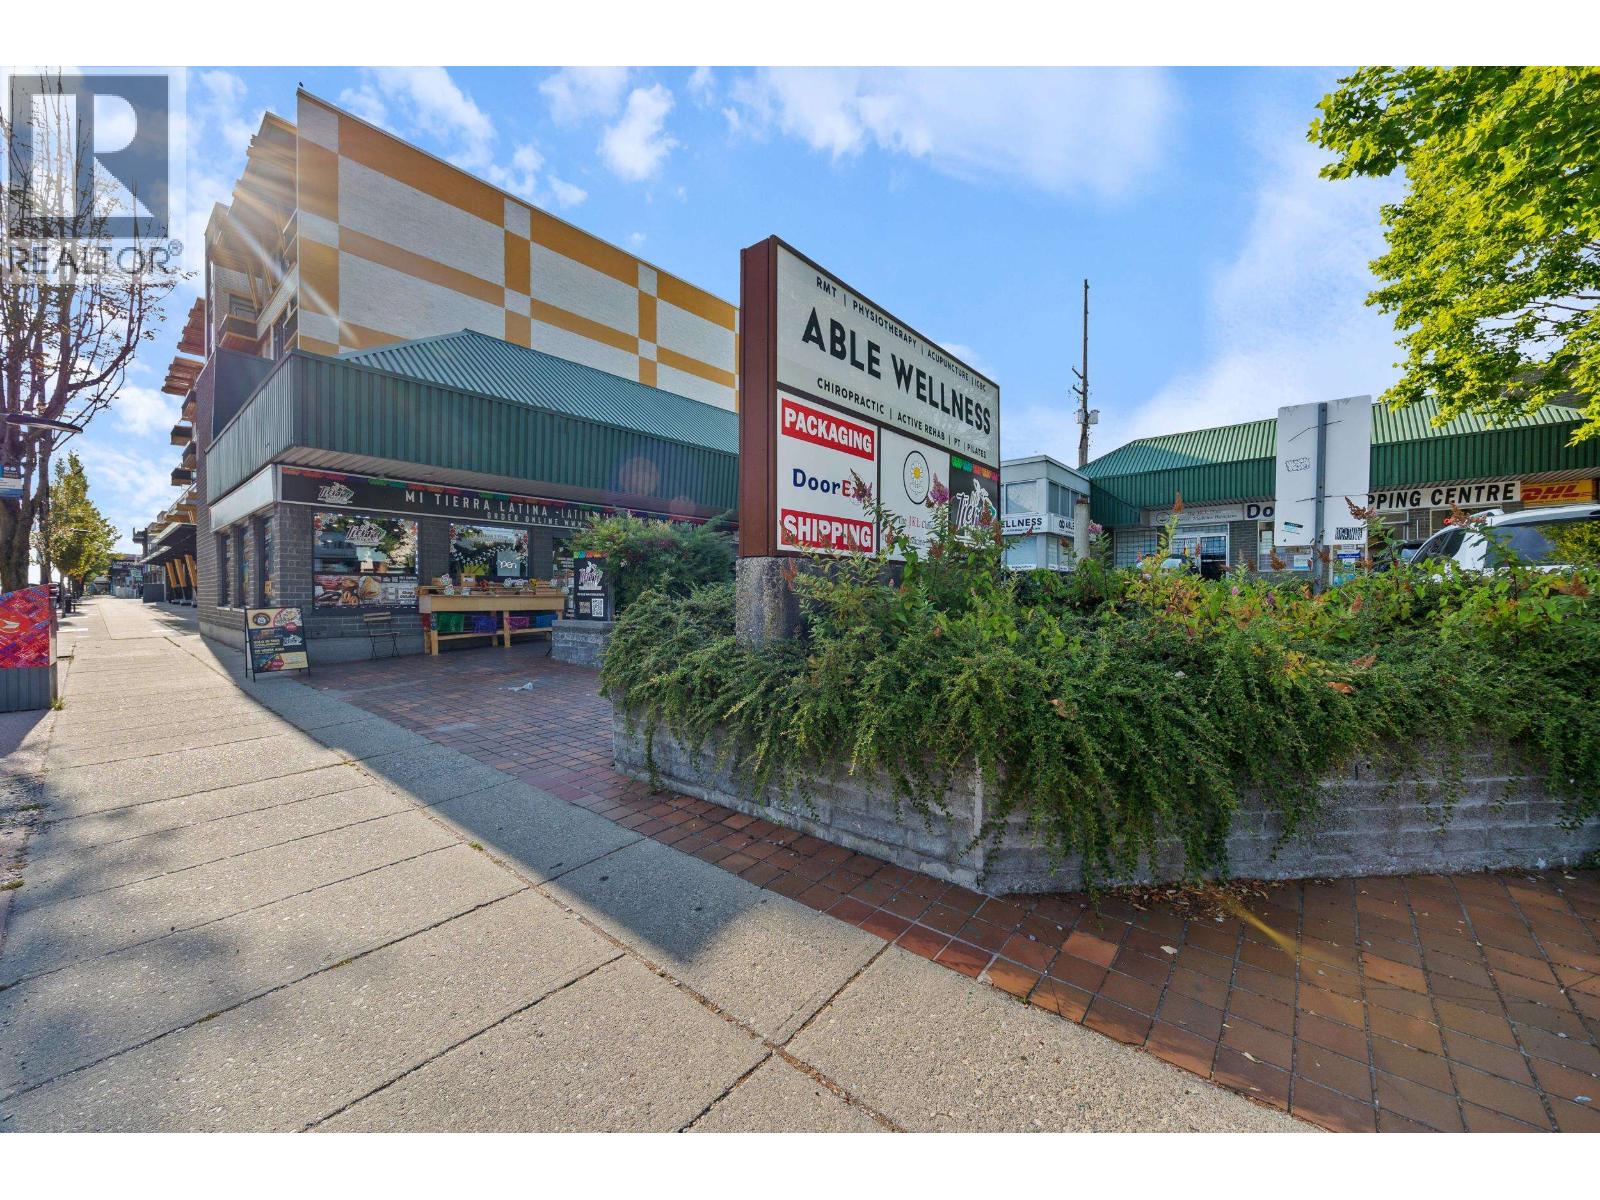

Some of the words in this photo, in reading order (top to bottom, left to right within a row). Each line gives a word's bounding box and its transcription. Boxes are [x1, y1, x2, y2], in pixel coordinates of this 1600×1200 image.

[816, 276, 837, 298] RMT
[852, 300, 917, 349] PHYSIOTHERAPY
[927, 349, 969, 382] ACUPUNCTURE
[974, 378, 987, 393] ICBC
[801, 306, 882, 381] ABLE
[890, 353, 991, 435] WELLNESS
[784, 406, 873, 454] PACKAGING
[817, 377, 885, 415] CHIROPRACTIC
[897, 411, 923, 431] ACTIVE
[924, 423, 946, 441] REHAB
[953, 437, 961, 448] PT
[967, 443, 987, 459] PILATES
[405, 490, 423, 504] MI
[434, 493, 491, 511] TIERRA
[499, 501, 548, 517] LATINA
[1430, 482, 1516, 506] CENTRE
[1521, 484, 1581, 501] DHL
[486, 511, 519, 522] ORDER
[525, 515, 559, 527] ONLINE
[1247, 503, 1274, 519] Do
[783, 514, 873, 548] SHIPPING
